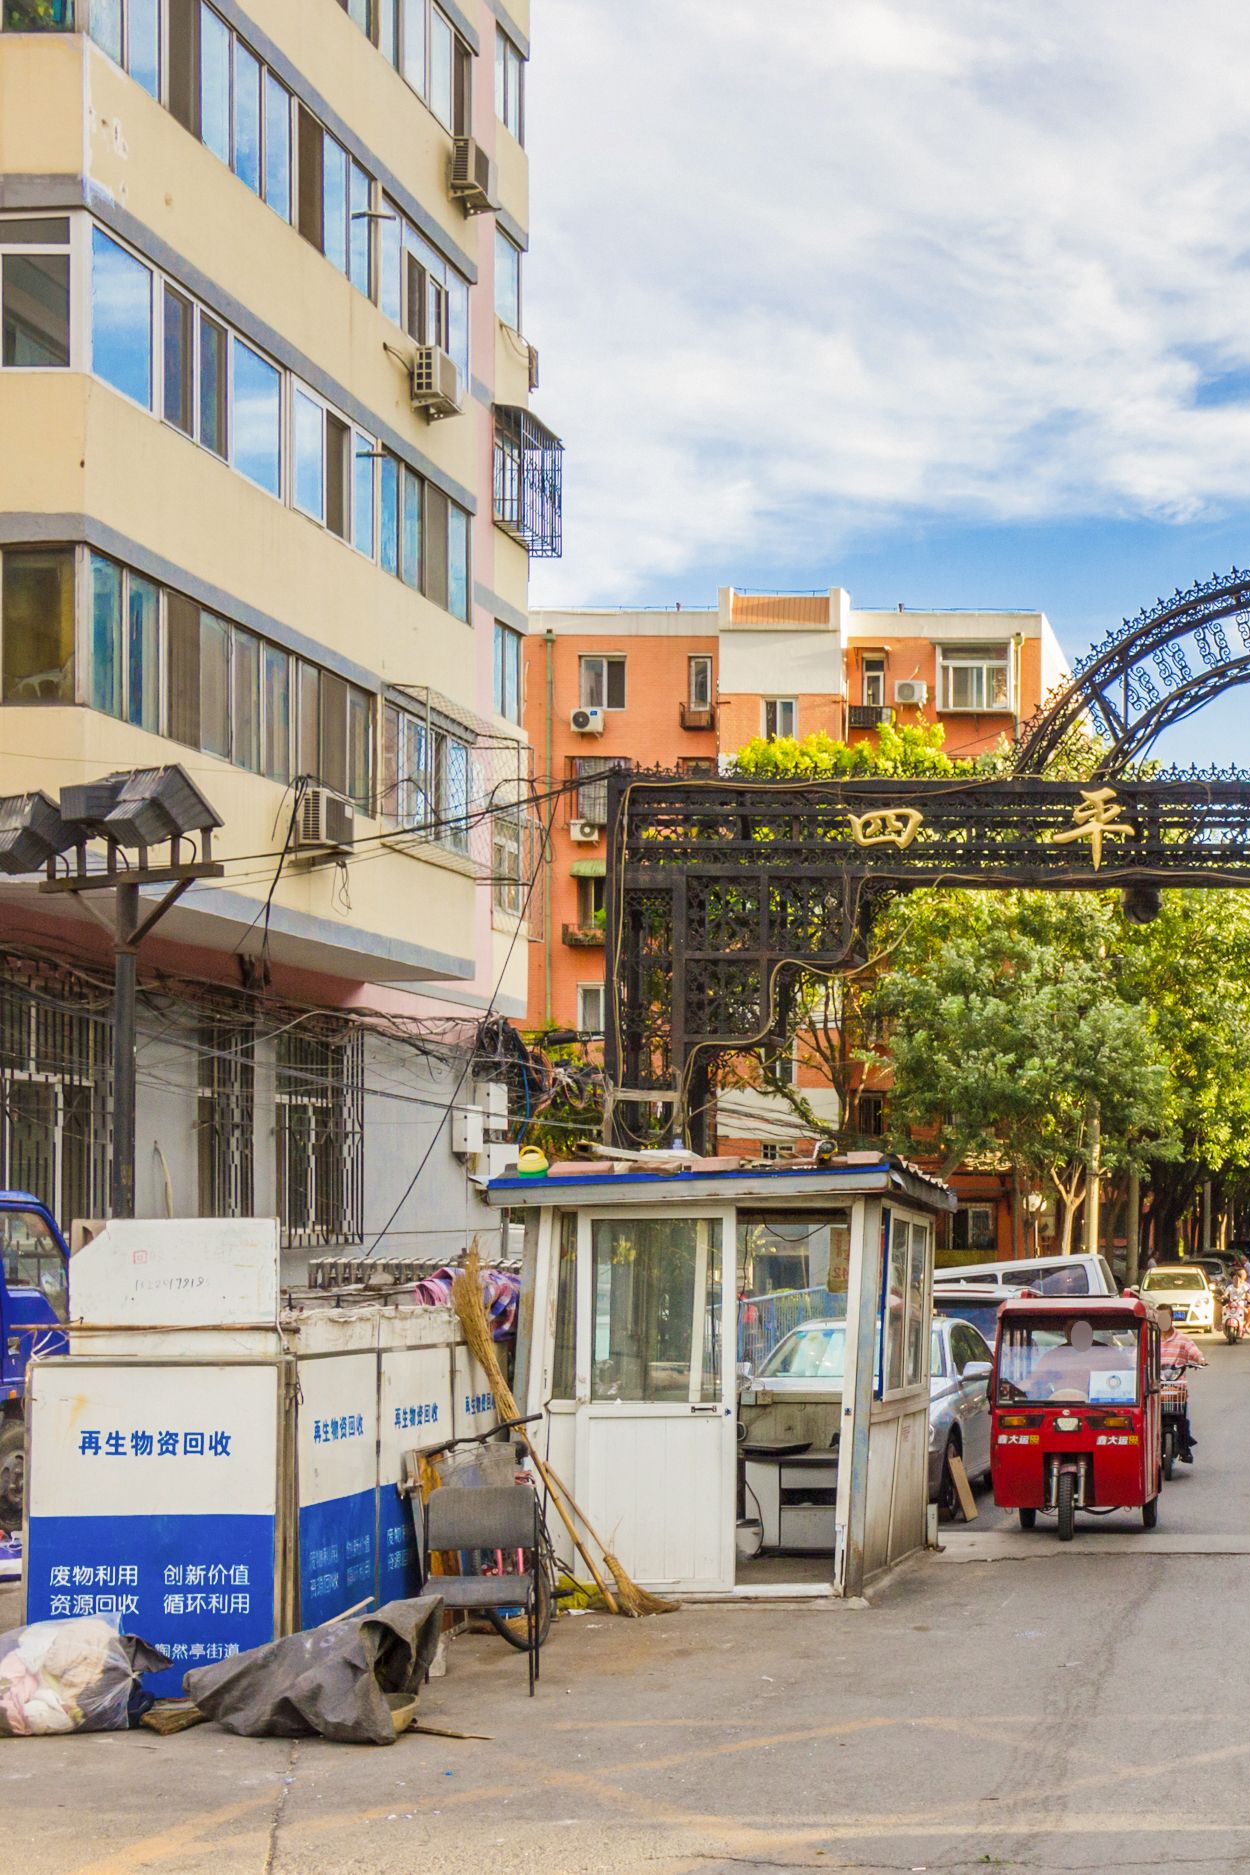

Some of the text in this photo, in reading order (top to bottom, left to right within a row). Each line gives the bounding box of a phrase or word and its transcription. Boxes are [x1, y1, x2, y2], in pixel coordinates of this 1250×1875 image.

[313, 1413, 364, 1444] 再生物资回收
[394, 1402, 439, 1429] 再生物资回收
[78, 1429, 232, 1457] 再生物资回收
[48, 1563, 251, 1588] 废物利用 创新价值
[49, 1592, 251, 1617] 资源回收 循环利用
